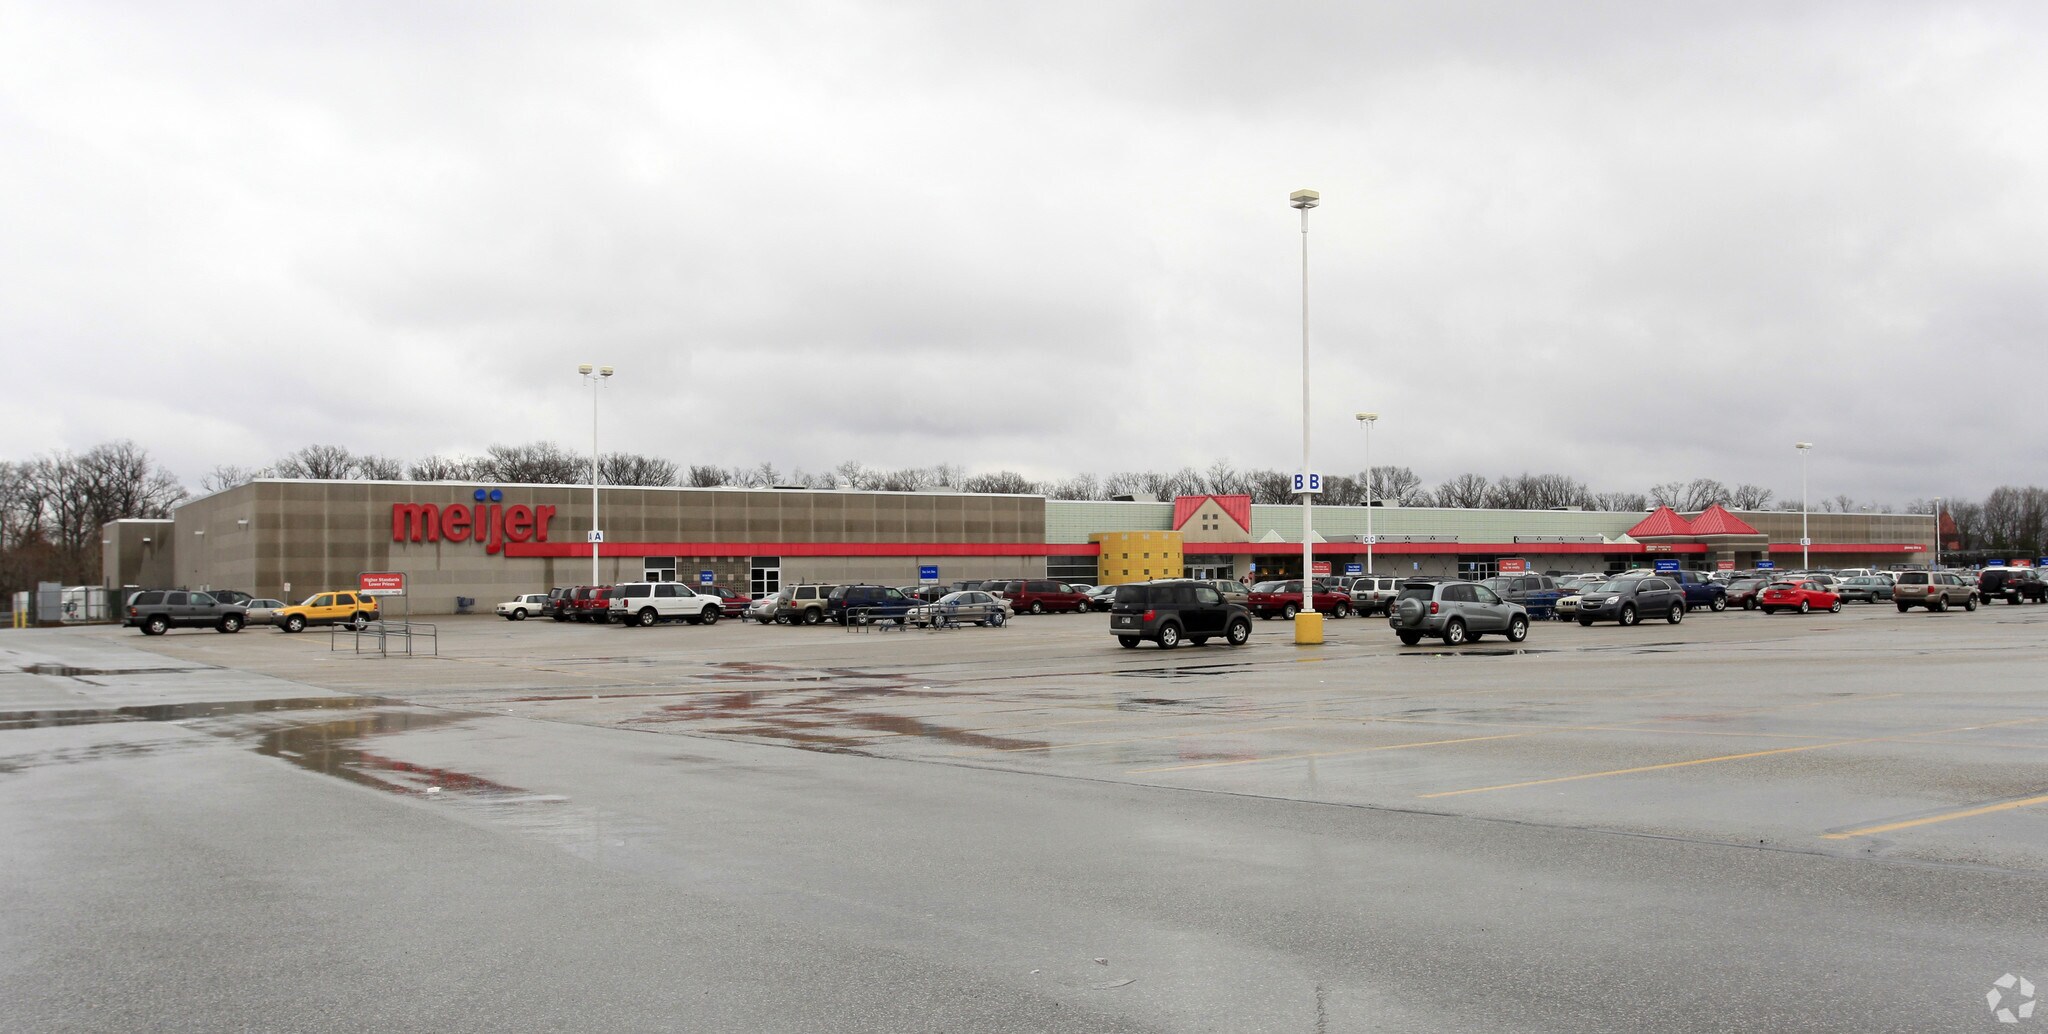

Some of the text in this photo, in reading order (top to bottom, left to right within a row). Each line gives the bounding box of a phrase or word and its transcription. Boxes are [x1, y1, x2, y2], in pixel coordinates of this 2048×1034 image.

[1294, 474, 1304, 490] B
[1309, 473, 1320, 490] B
[392, 488, 556, 555] meijer
[595, 532, 601, 541] A
